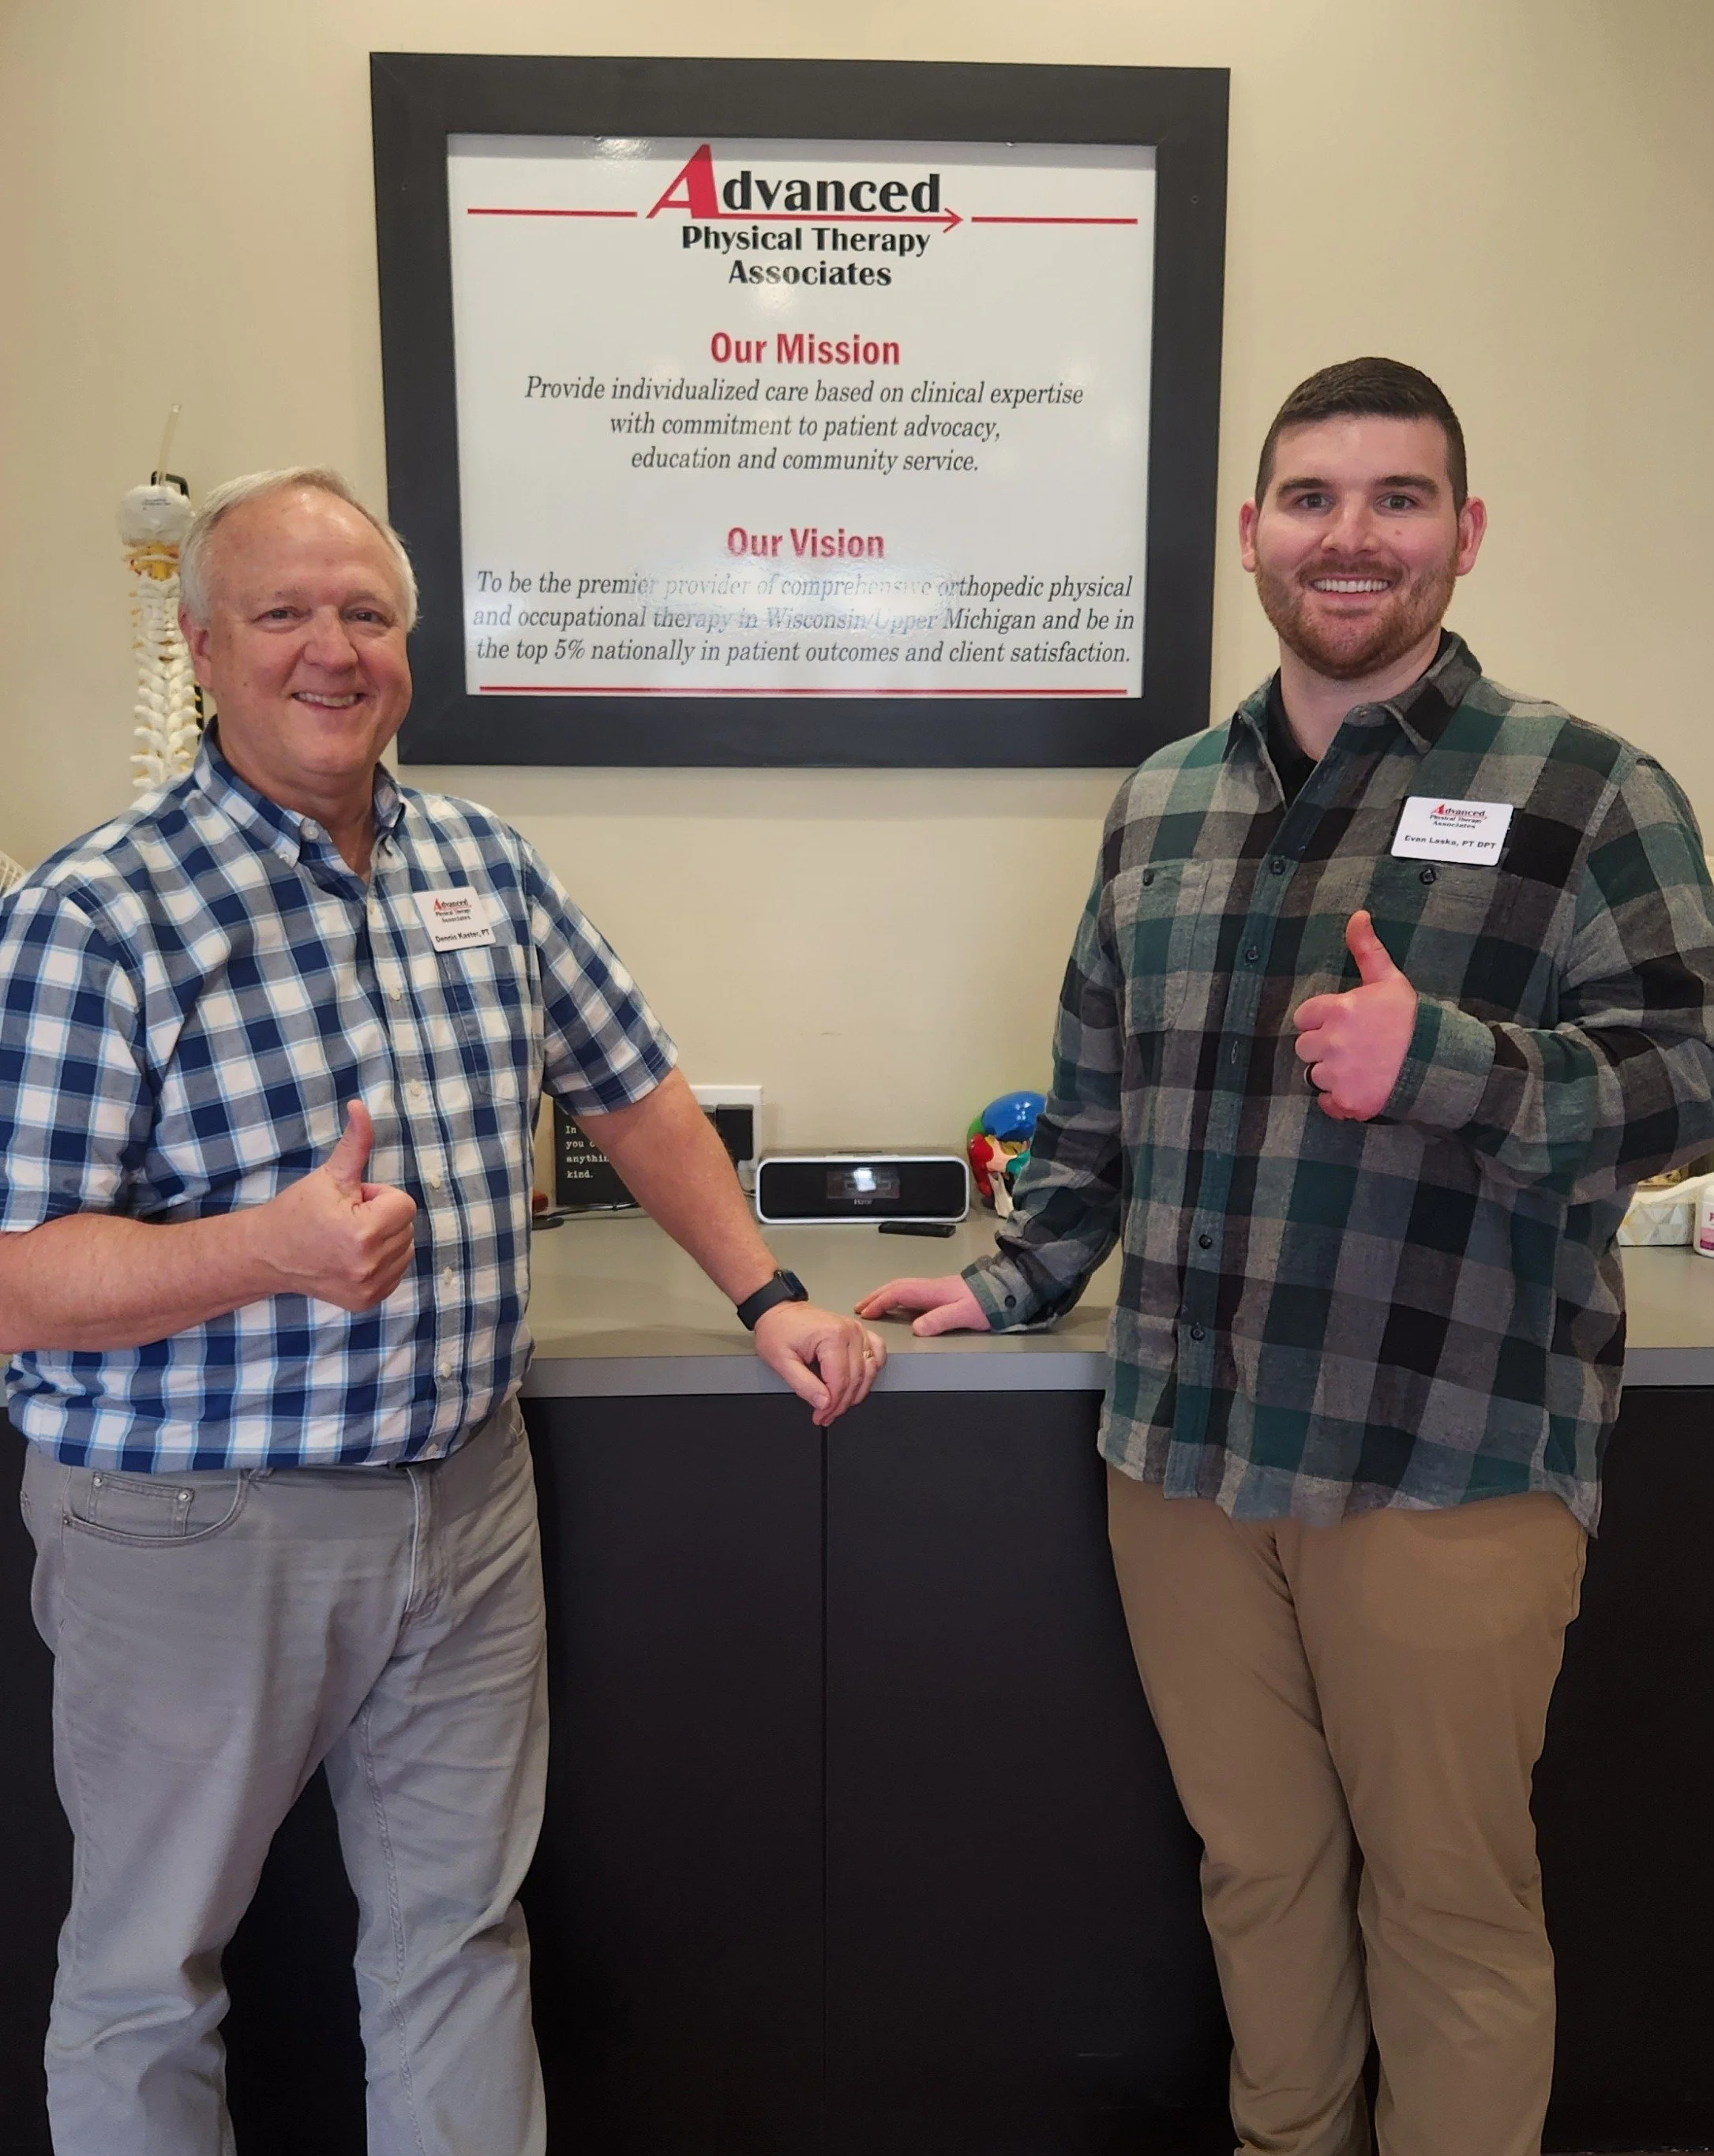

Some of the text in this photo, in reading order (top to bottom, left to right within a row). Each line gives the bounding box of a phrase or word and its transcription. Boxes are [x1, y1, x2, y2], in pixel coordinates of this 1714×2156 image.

[646, 143, 942, 219] Advanced
[682, 225, 931, 257] Physical Therapy
[729, 260, 892, 286] Associates
[711, 332, 899, 366] Our Mission
[524, 376, 1083, 409] Provide individualized care based on clinical expertise
[610, 411, 1000, 442] with commitment to patient advocacy,
[632, 446, 977, 475] education and community service.
[727, 527, 884, 558] Our Vision
[478, 571, 502, 592] To
[509, 571, 531, 593] be
[539, 572, 571, 593] the
[578, 572, 658, 598] premier
[665, 574, 749, 600] provider
[758, 575, 781, 594] of
[938, 575, 1043, 602] orthopedic
[1047, 575, 1133, 602] physical
[473, 606, 512, 628] and
[519, 606, 647, 632] occupational
[653, 607, 732, 634] therapy
[738, 608, 758, 628] in
[943, 608, 1035, 635] Michigan
[1042, 608, 1081, 629] and
[1086, 608, 1109, 629] be
[1115, 609, 1134, 629] in
[478, 638, 1129, 666] the top 5% nationally in patient outcomes and client satisfaction.
[1431, 804, 1485, 816] Advanced
[435, 934, 457, 943] Dennis
[566, 1141, 584, 1149] you
[566, 1170, 594, 1179] kind.
